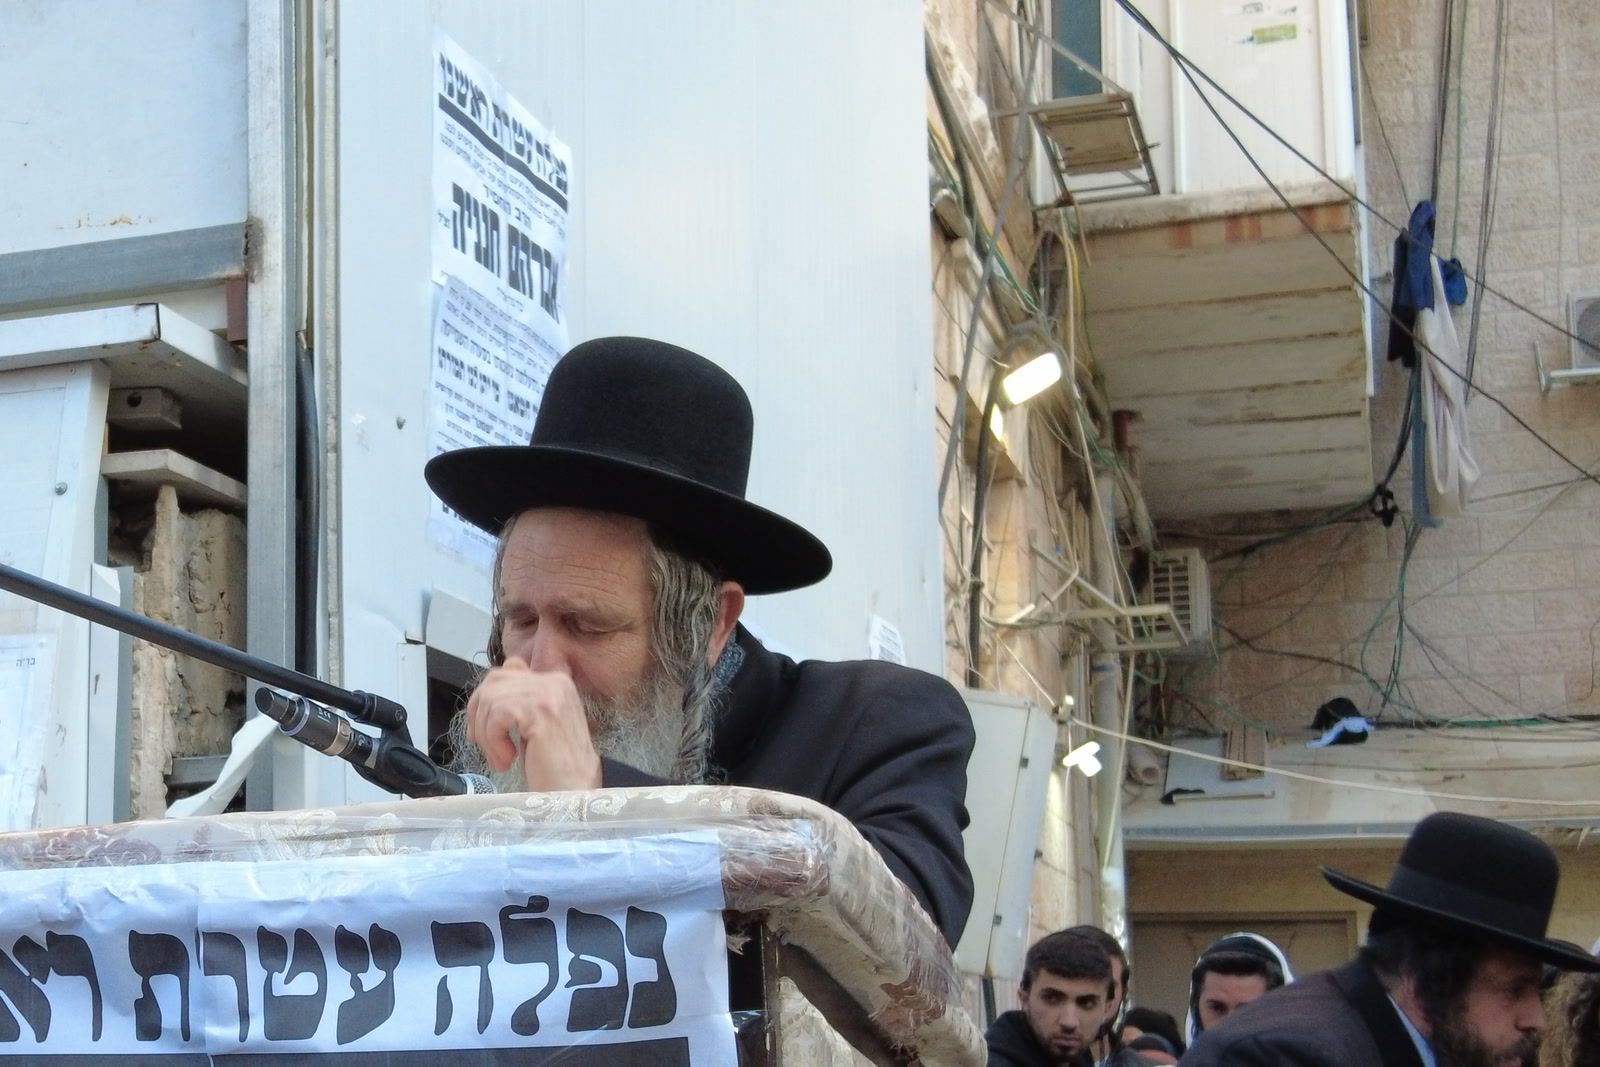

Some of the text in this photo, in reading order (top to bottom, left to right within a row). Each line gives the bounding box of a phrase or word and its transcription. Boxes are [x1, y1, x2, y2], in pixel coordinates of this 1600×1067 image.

[439, 52, 489, 131] ראשנו
[452, 182, 501, 279] חנניה
[508, 223, 560, 325] אברהם
[128, 921, 402, 1046] עטרת
[431, 895, 677, 1037] נפלה
